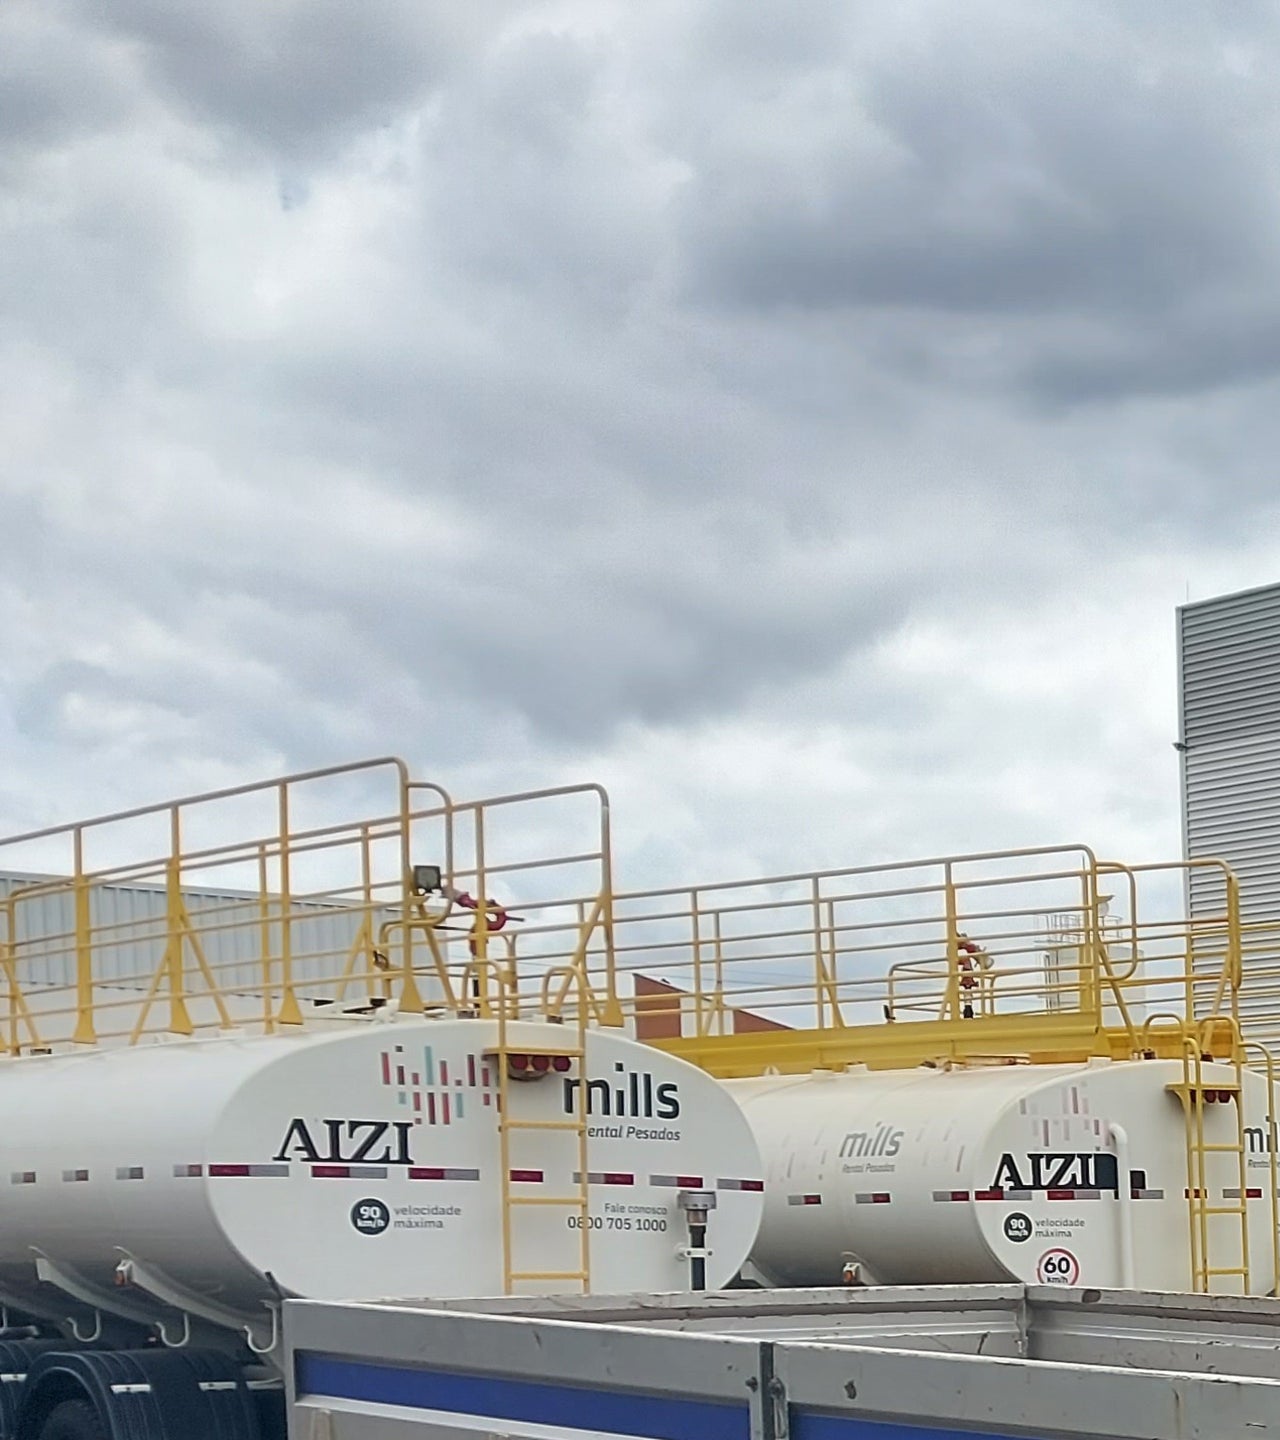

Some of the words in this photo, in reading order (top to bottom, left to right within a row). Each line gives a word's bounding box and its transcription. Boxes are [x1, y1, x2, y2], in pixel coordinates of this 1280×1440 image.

[563, 1062, 680, 1120] mills
[579, 1125, 624, 1139] ental
[626, 1125, 681, 1142] Pesados
[838, 1120, 905, 1158] mills
[272, 1117, 415, 1166] AIZI
[988, 1153, 1095, 1192] AIZI
[359, 1206, 382, 1219] 90
[393, 1205, 462, 1217] velocidade
[604, 1203, 627, 1214] Fale
[393, 1217, 444, 1230] máxima
[606, 1217, 632, 1230] 705
[636, 1218, 667, 1232] 1000
[1010, 1218, 1026, 1230] 90
[1034, 1218, 1086, 1229] velocidade
[1034, 1229, 1073, 1239] máxima
[1043, 1256, 1071, 1275] 60
